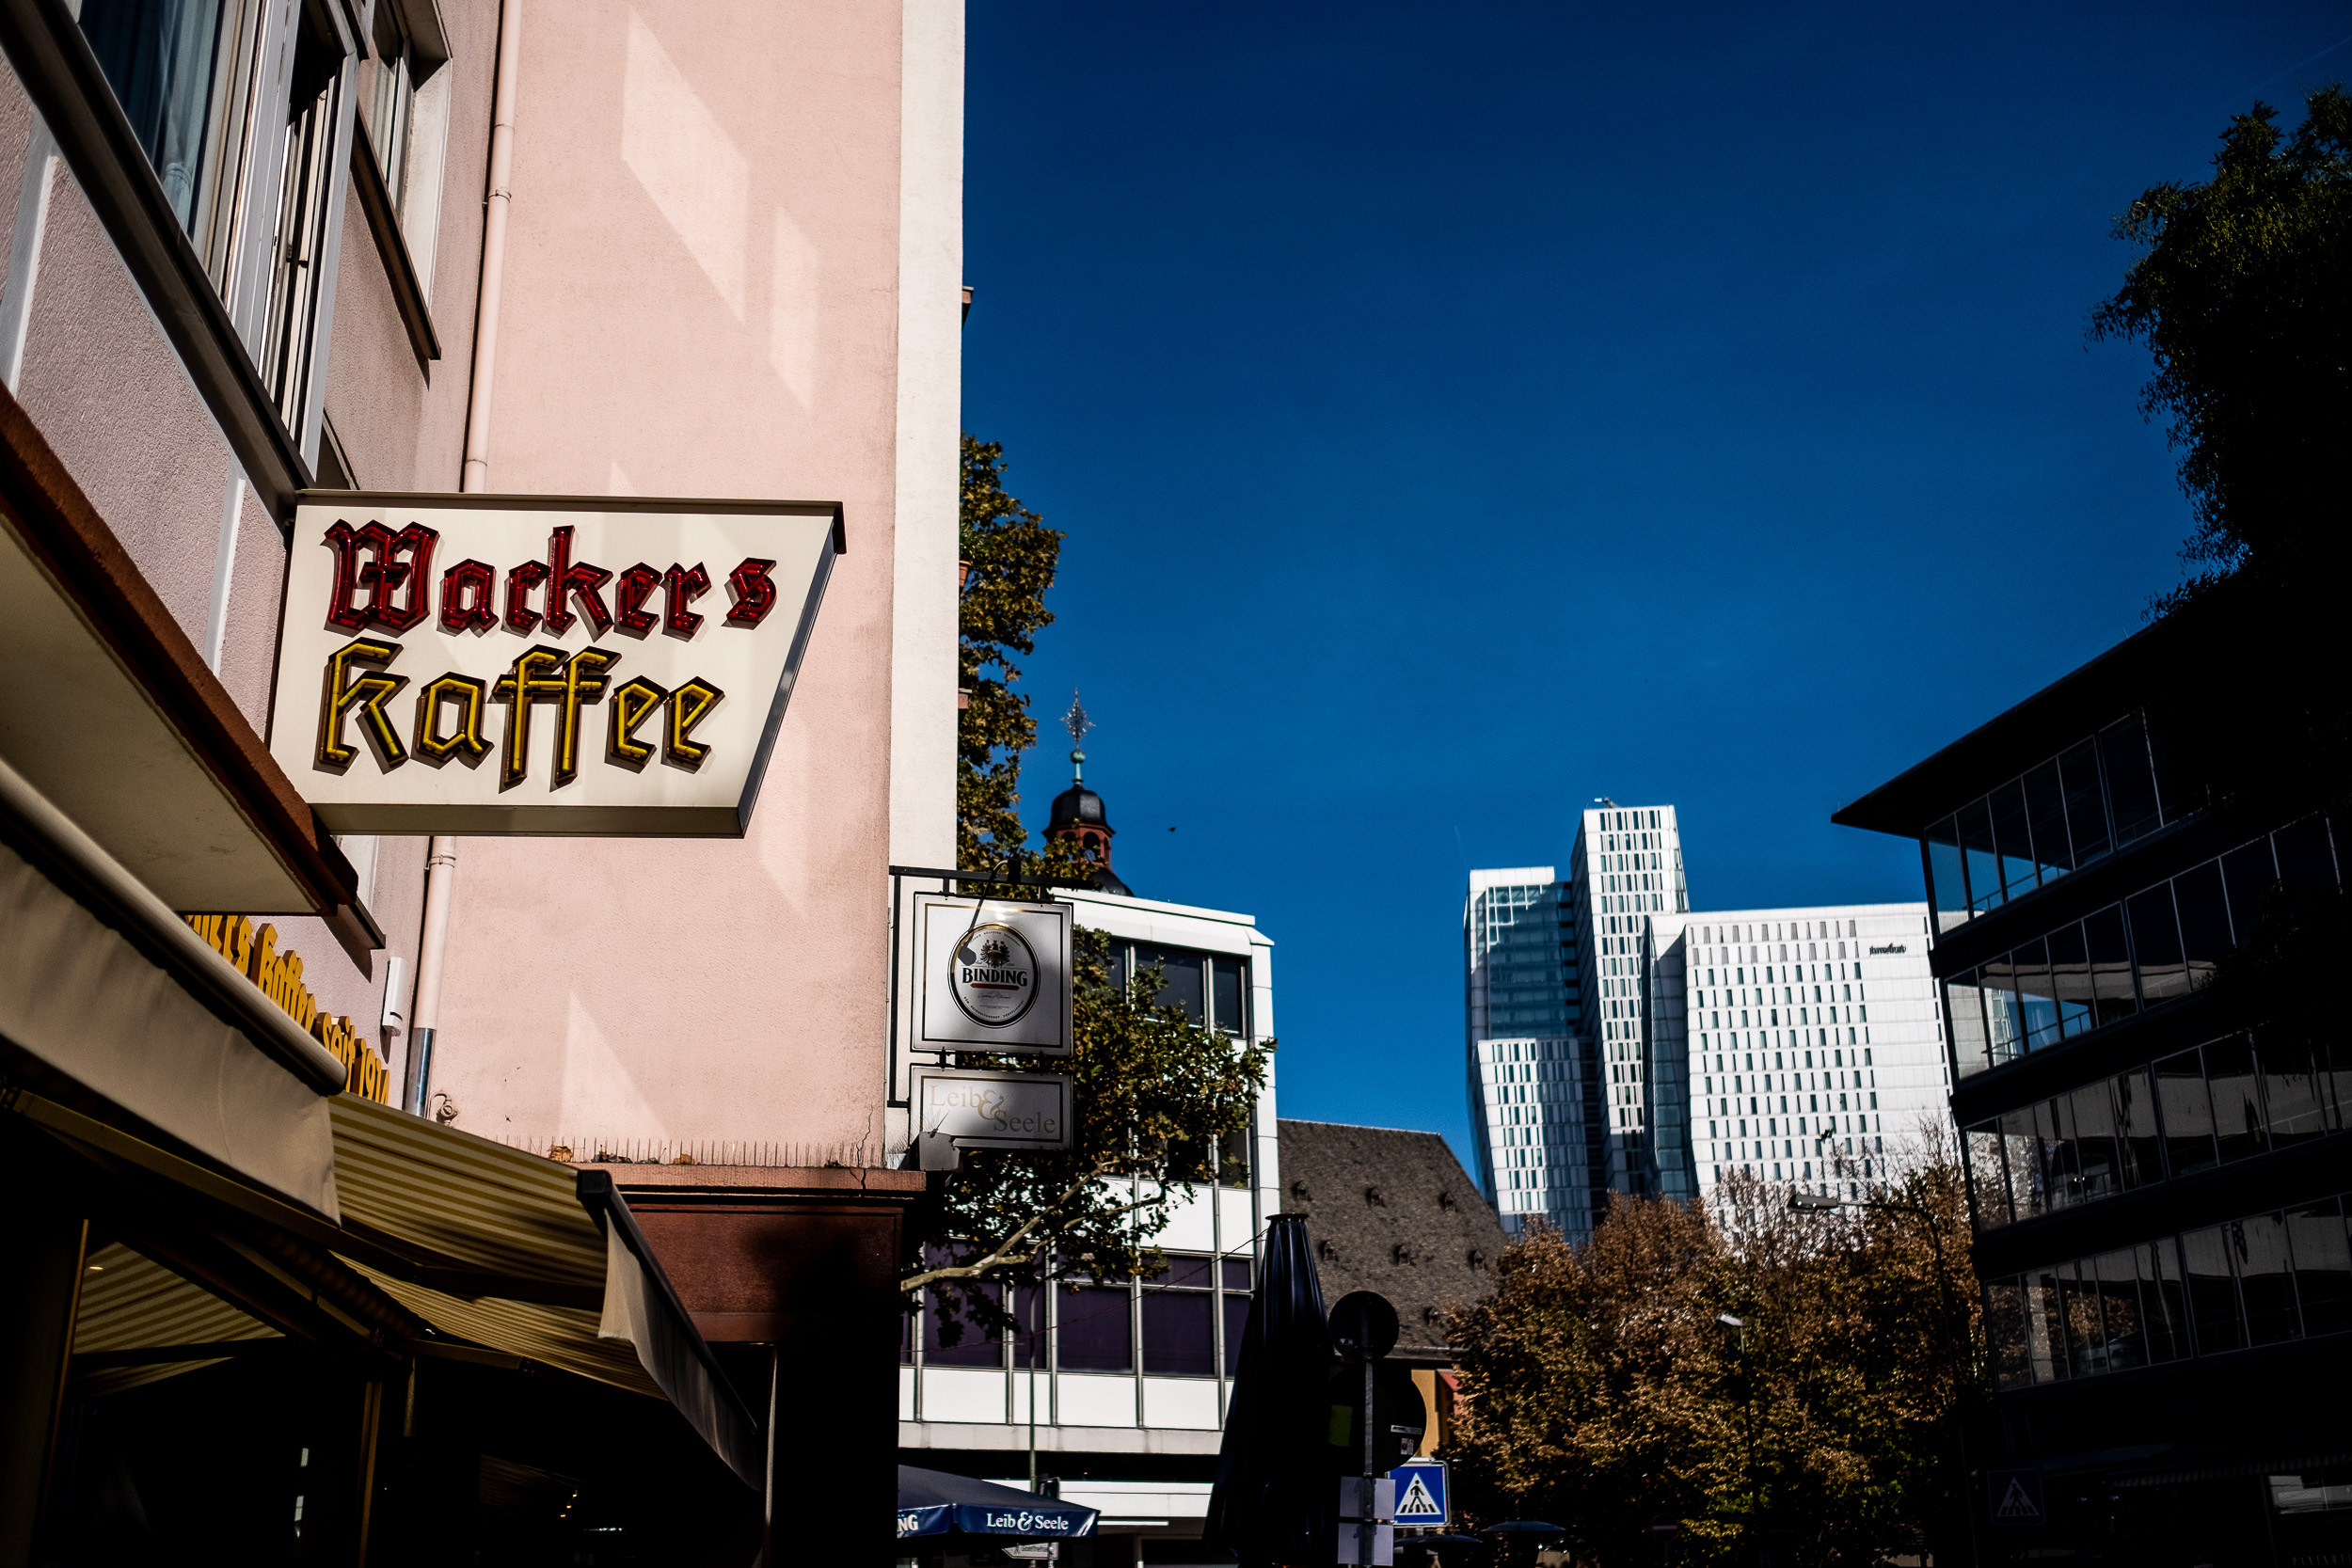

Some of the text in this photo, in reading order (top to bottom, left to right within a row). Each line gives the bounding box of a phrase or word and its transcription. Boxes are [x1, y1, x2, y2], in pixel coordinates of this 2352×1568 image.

[315, 636, 726, 790] Kaffee
[962, 967, 1028, 988] BINDING
[929, 1085, 980, 1108] Leib
[993, 1111, 1057, 1134] Seele
[987, 1512, 1069, 1531] Leib & Seele
